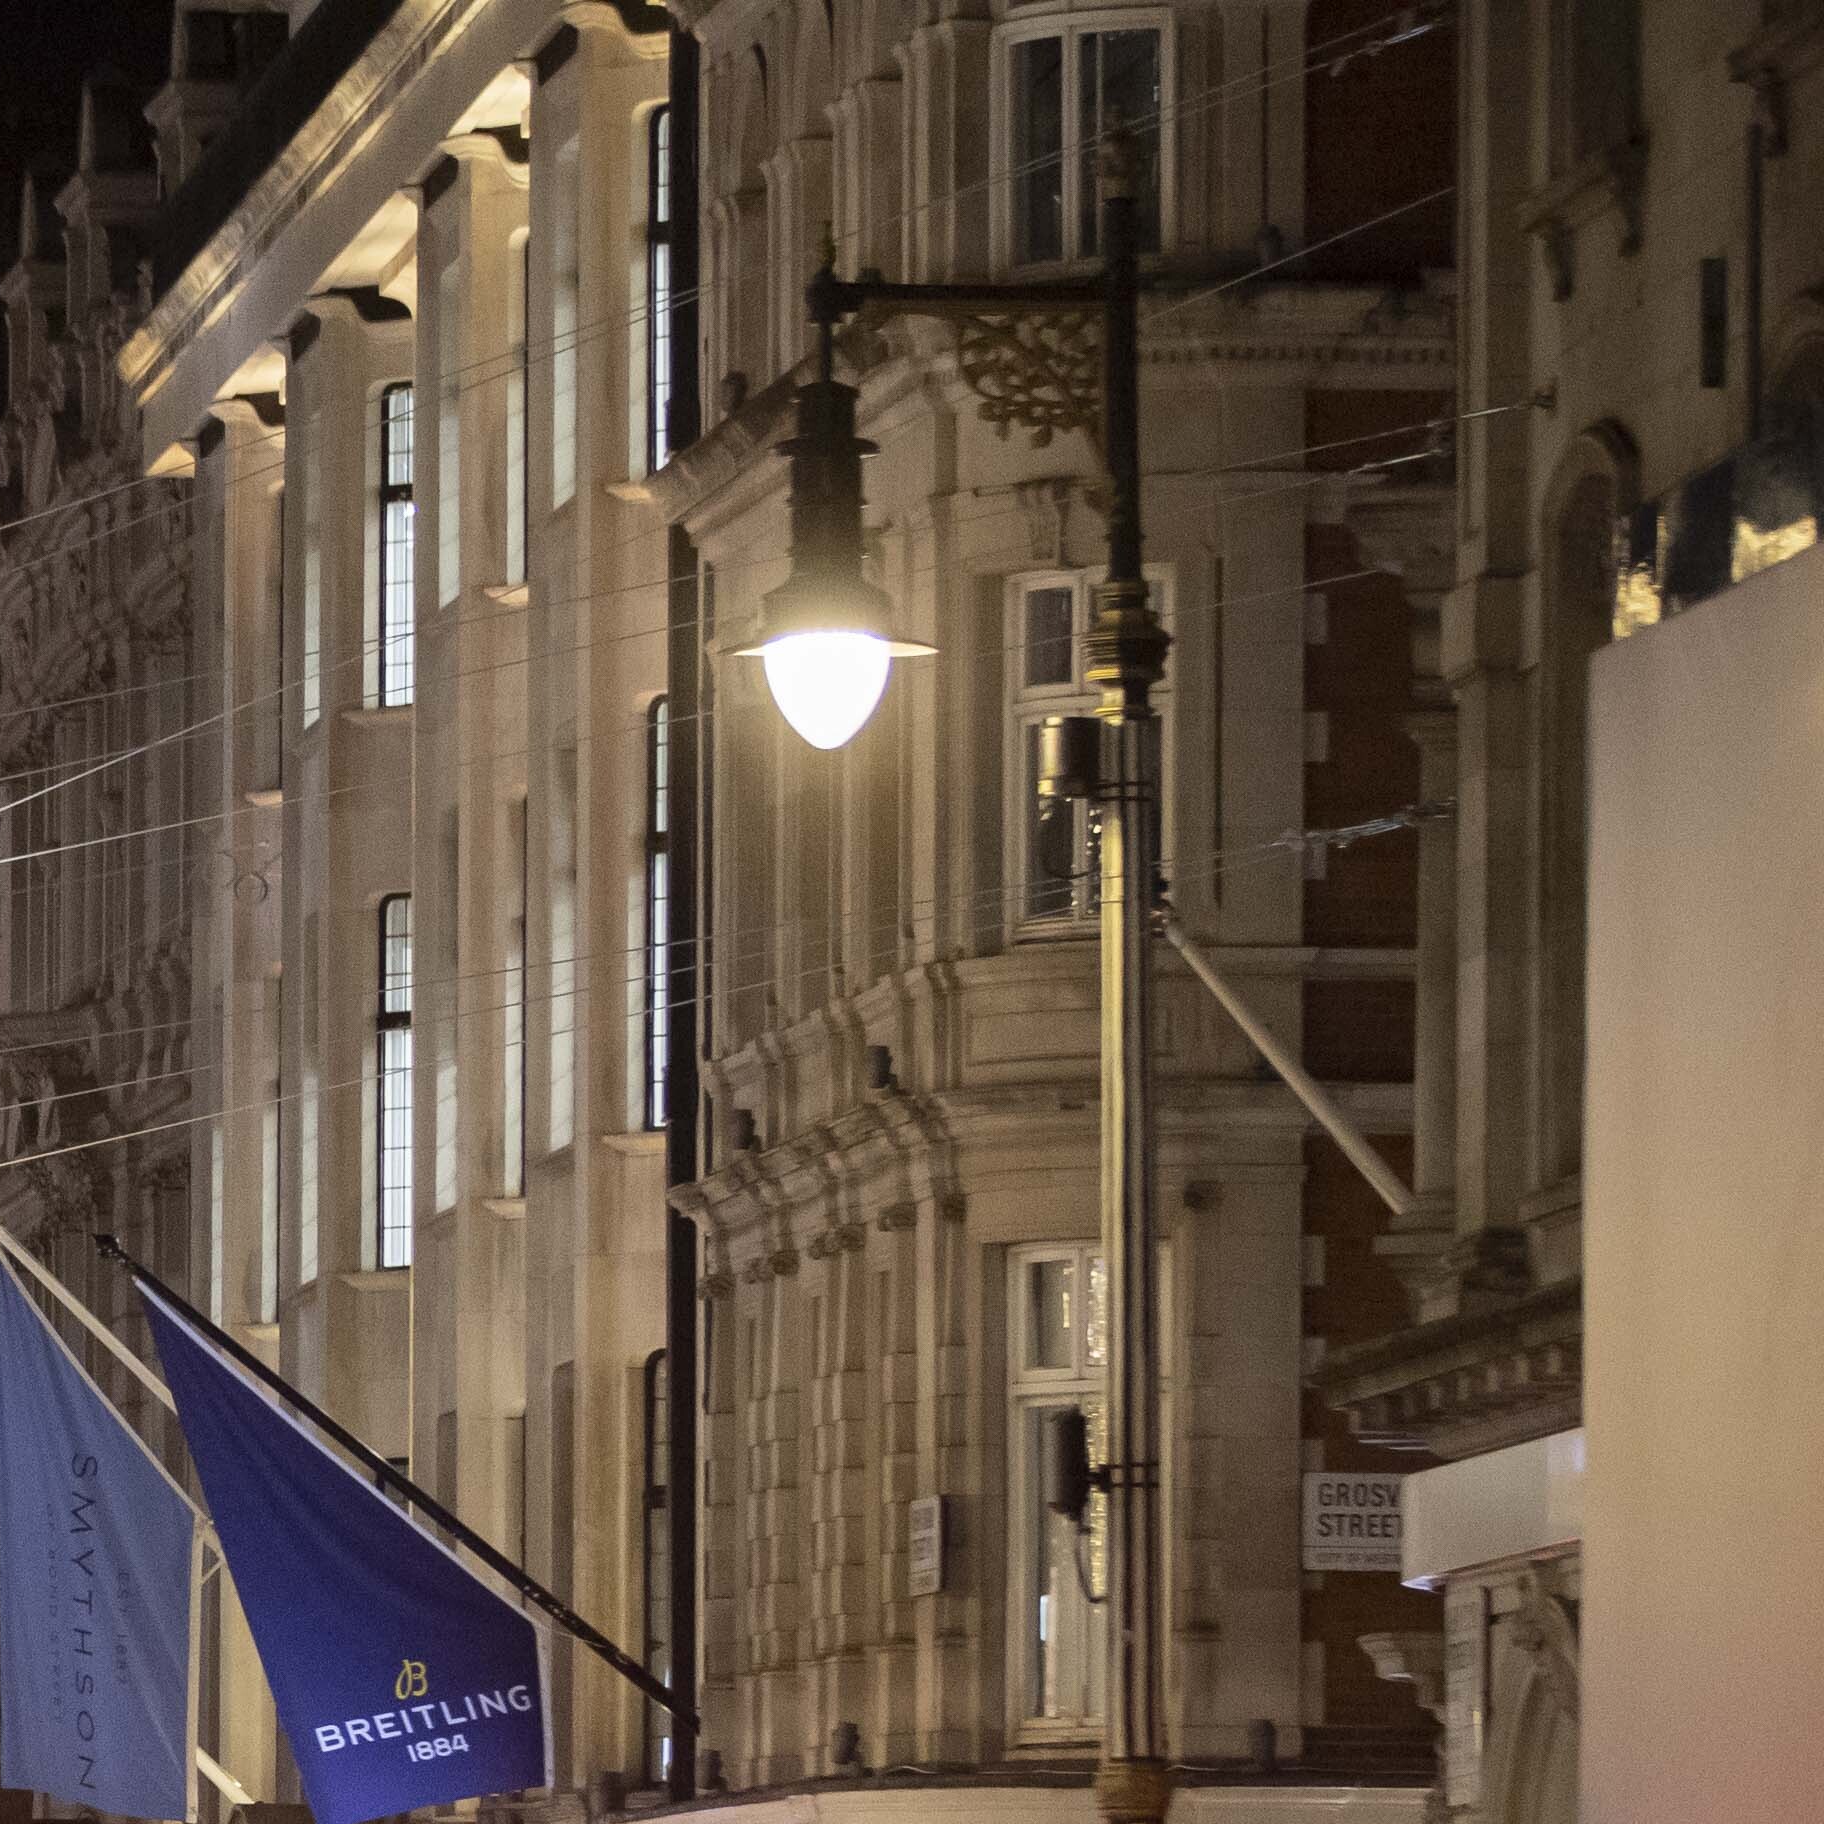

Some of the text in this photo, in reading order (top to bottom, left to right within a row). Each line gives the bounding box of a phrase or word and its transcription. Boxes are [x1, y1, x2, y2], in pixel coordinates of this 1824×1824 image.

[70, 1453, 98, 1790] SMYTHSON
[315, 1685, 532, 1752] BREITLING
[407, 1734, 470, 1762] 1884
